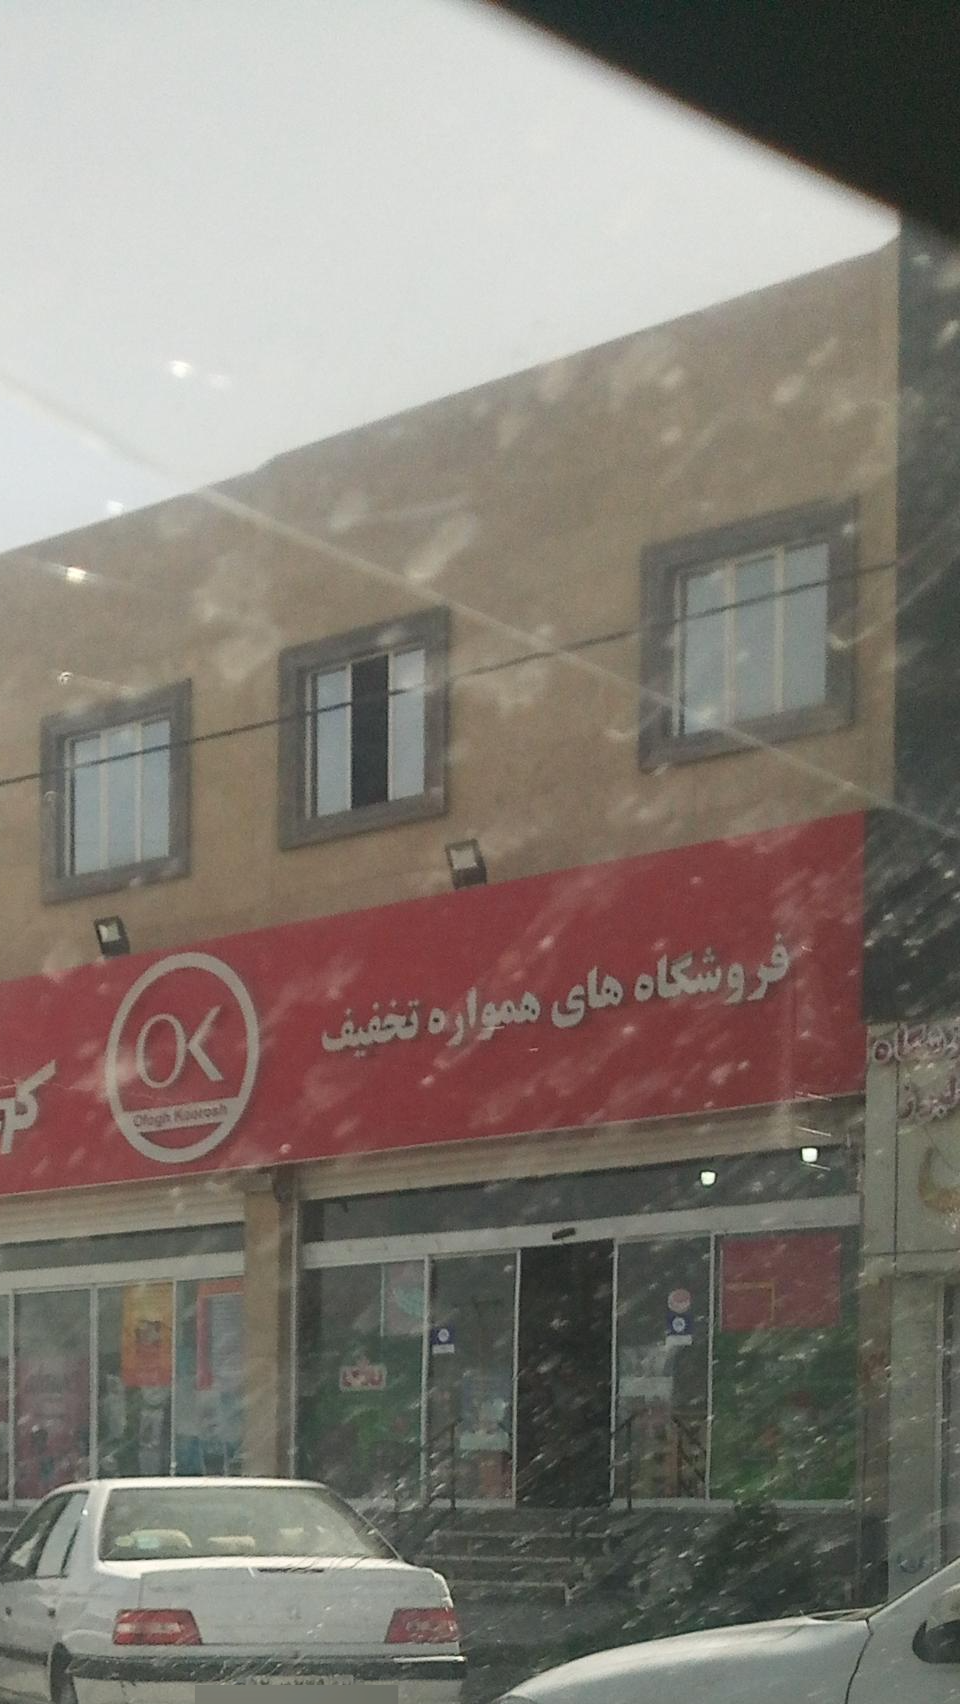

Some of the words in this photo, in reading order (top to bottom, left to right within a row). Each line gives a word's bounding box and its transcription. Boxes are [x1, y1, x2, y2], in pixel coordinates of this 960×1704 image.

[550, 966, 624, 1028] های
[634, 931, 792, 1004] فروشگاه
[137, 1005, 224, 1089] OK
[321, 999, 420, 1058] تخفیف
[427, 986, 540, 1047] همواره
